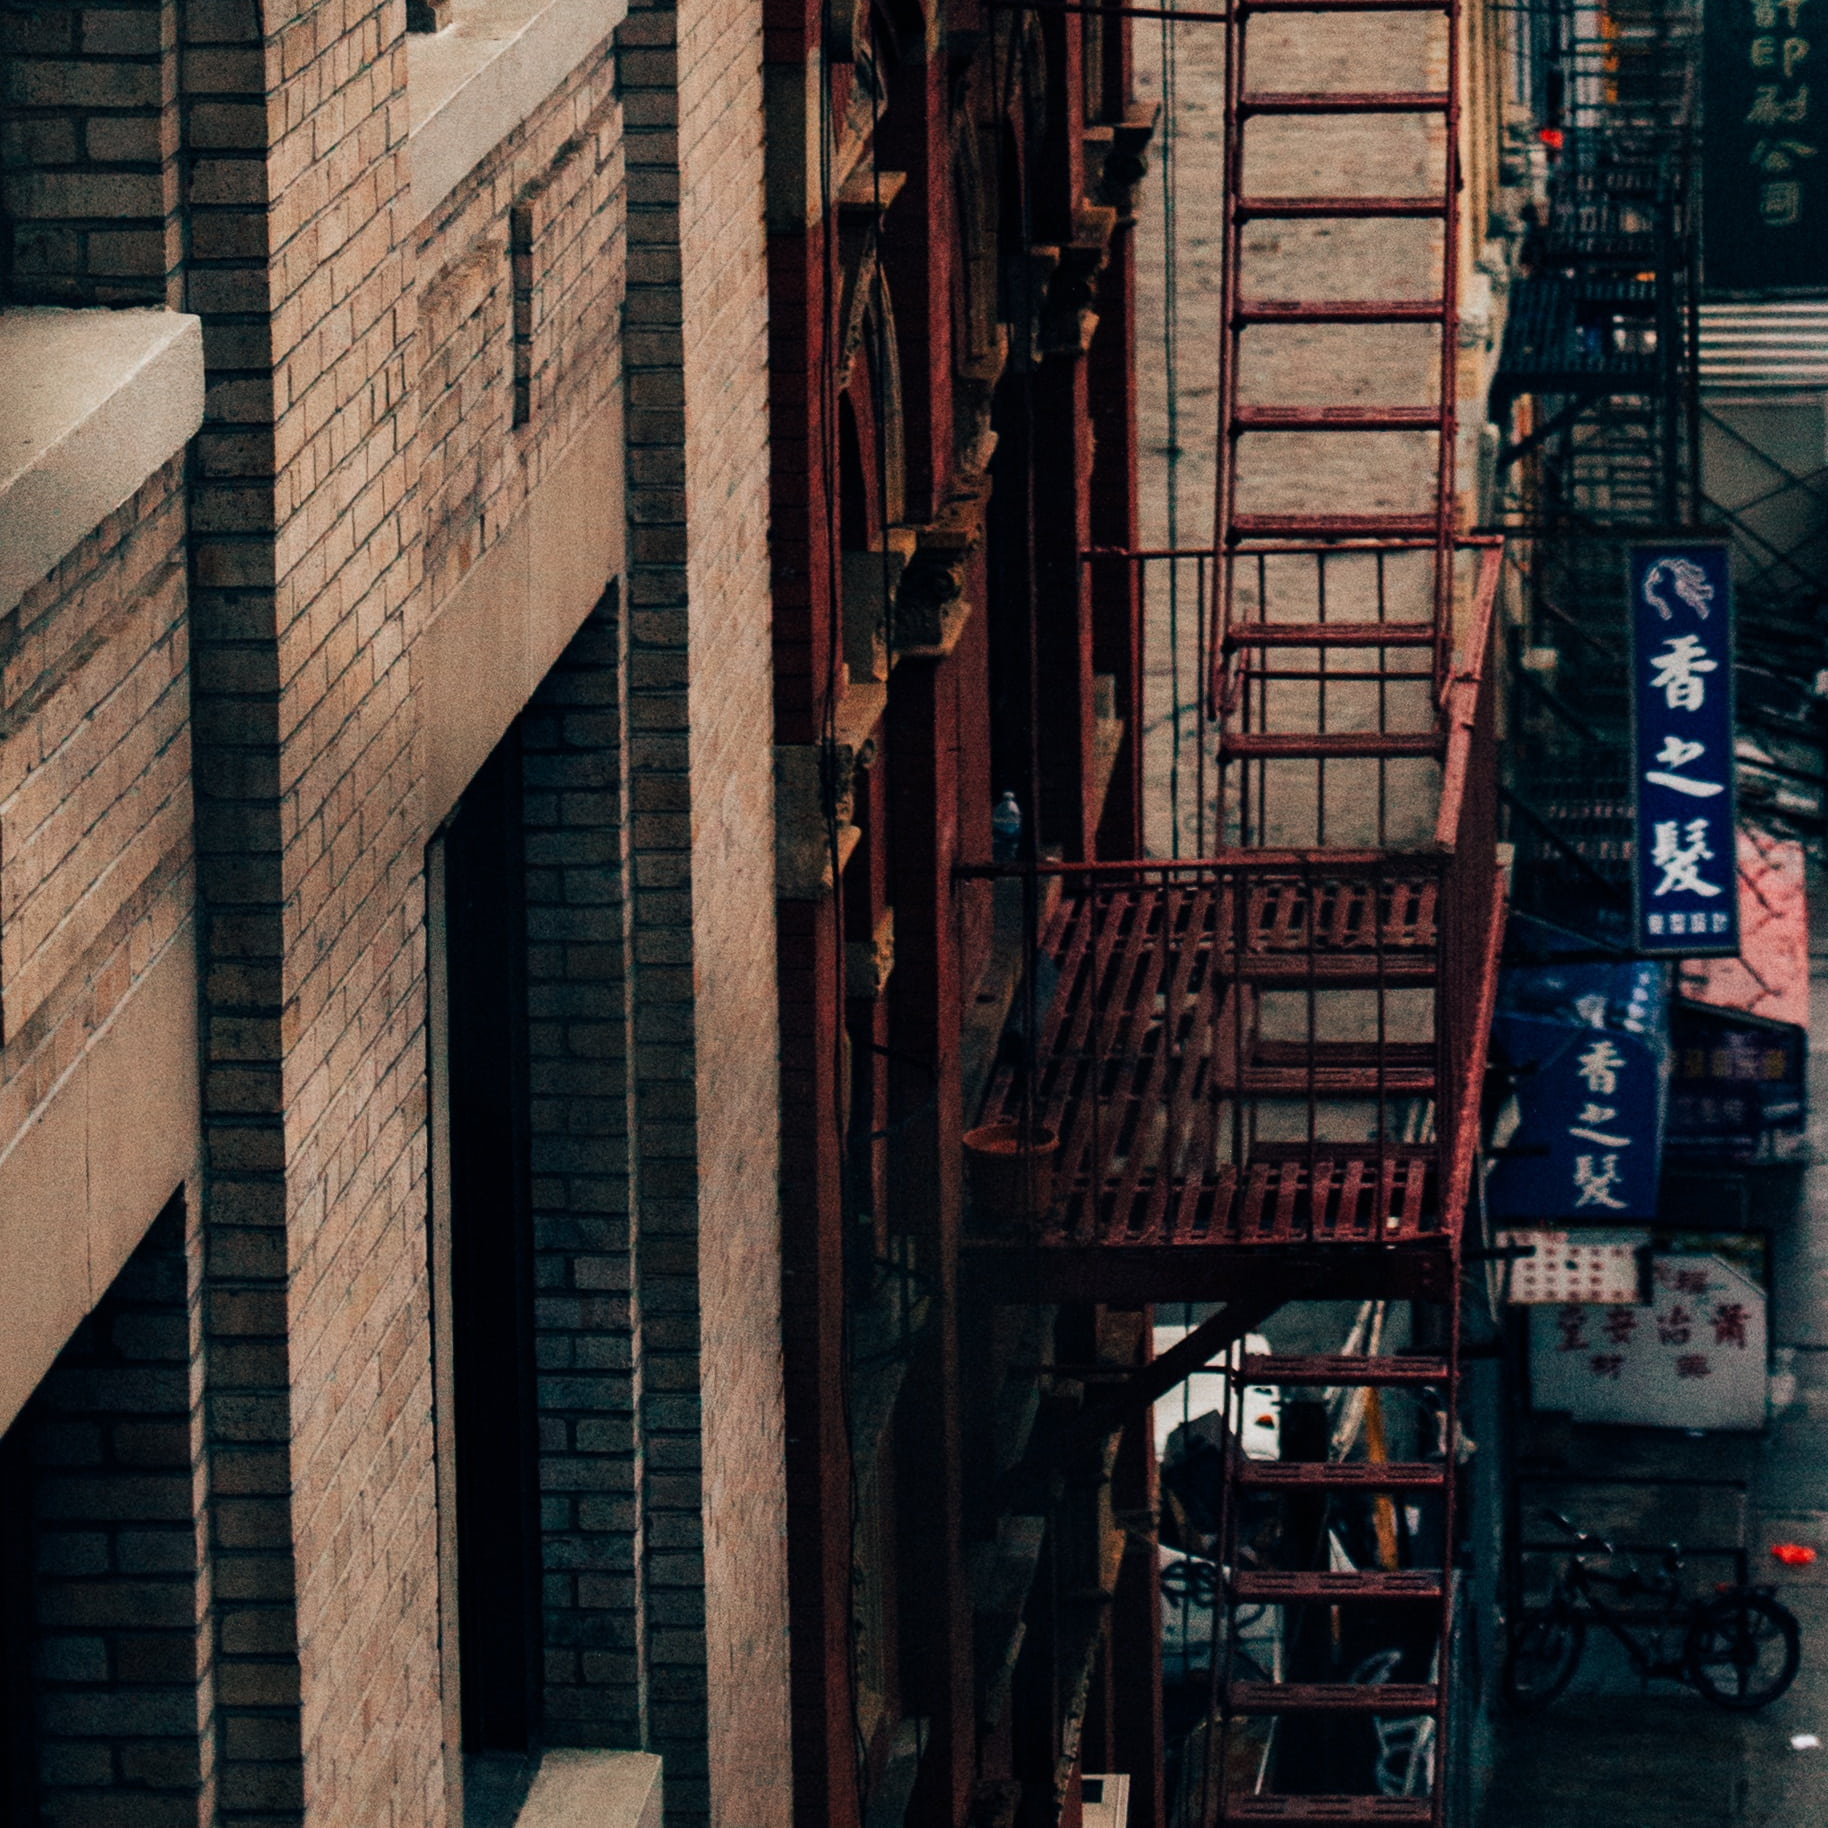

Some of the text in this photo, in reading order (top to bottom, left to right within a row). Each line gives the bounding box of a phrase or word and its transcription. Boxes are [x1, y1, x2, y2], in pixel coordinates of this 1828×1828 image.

[1645, 633, 1725, 898] 香之髮
[1568, 1039, 1633, 1209] 香之髮
